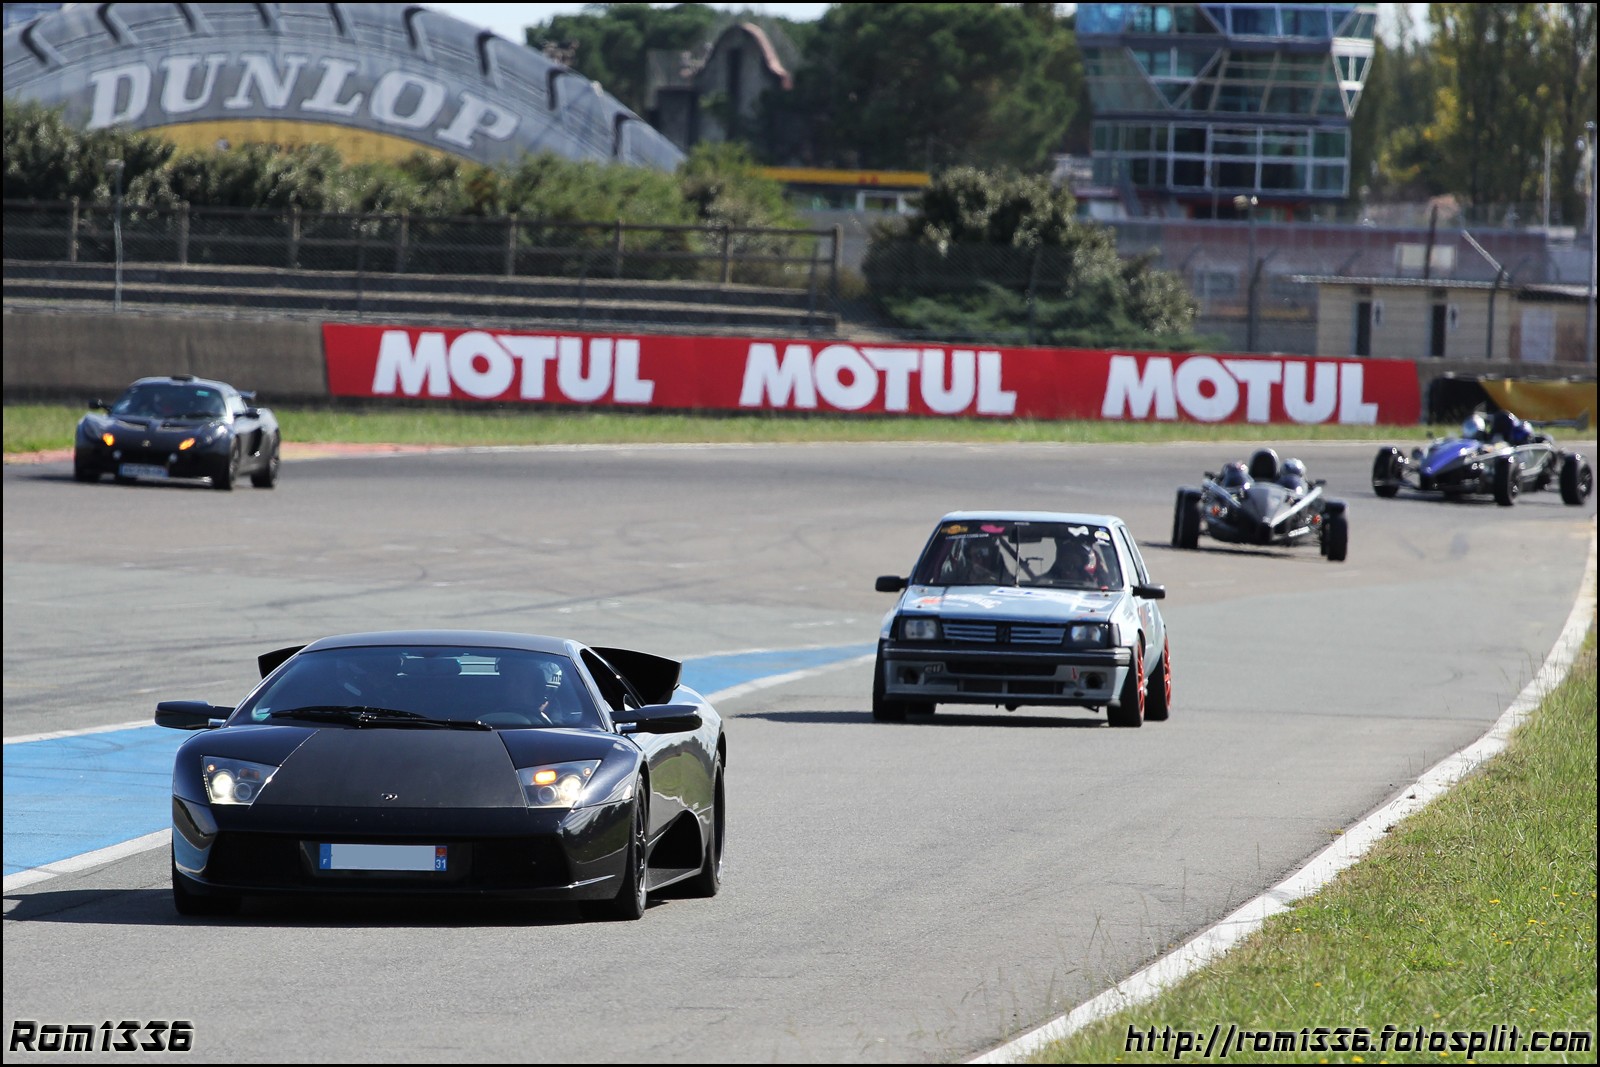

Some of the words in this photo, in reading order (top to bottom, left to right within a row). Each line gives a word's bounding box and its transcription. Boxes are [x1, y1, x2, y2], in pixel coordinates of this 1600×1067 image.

[87, 53, 519, 148] DUNLOP
[372, 330, 655, 404] MOTUL
[740, 343, 1017, 415] MOTUL
[1102, 356, 1378, 425] MOTUL
[435, 859, 447, 869] 31
